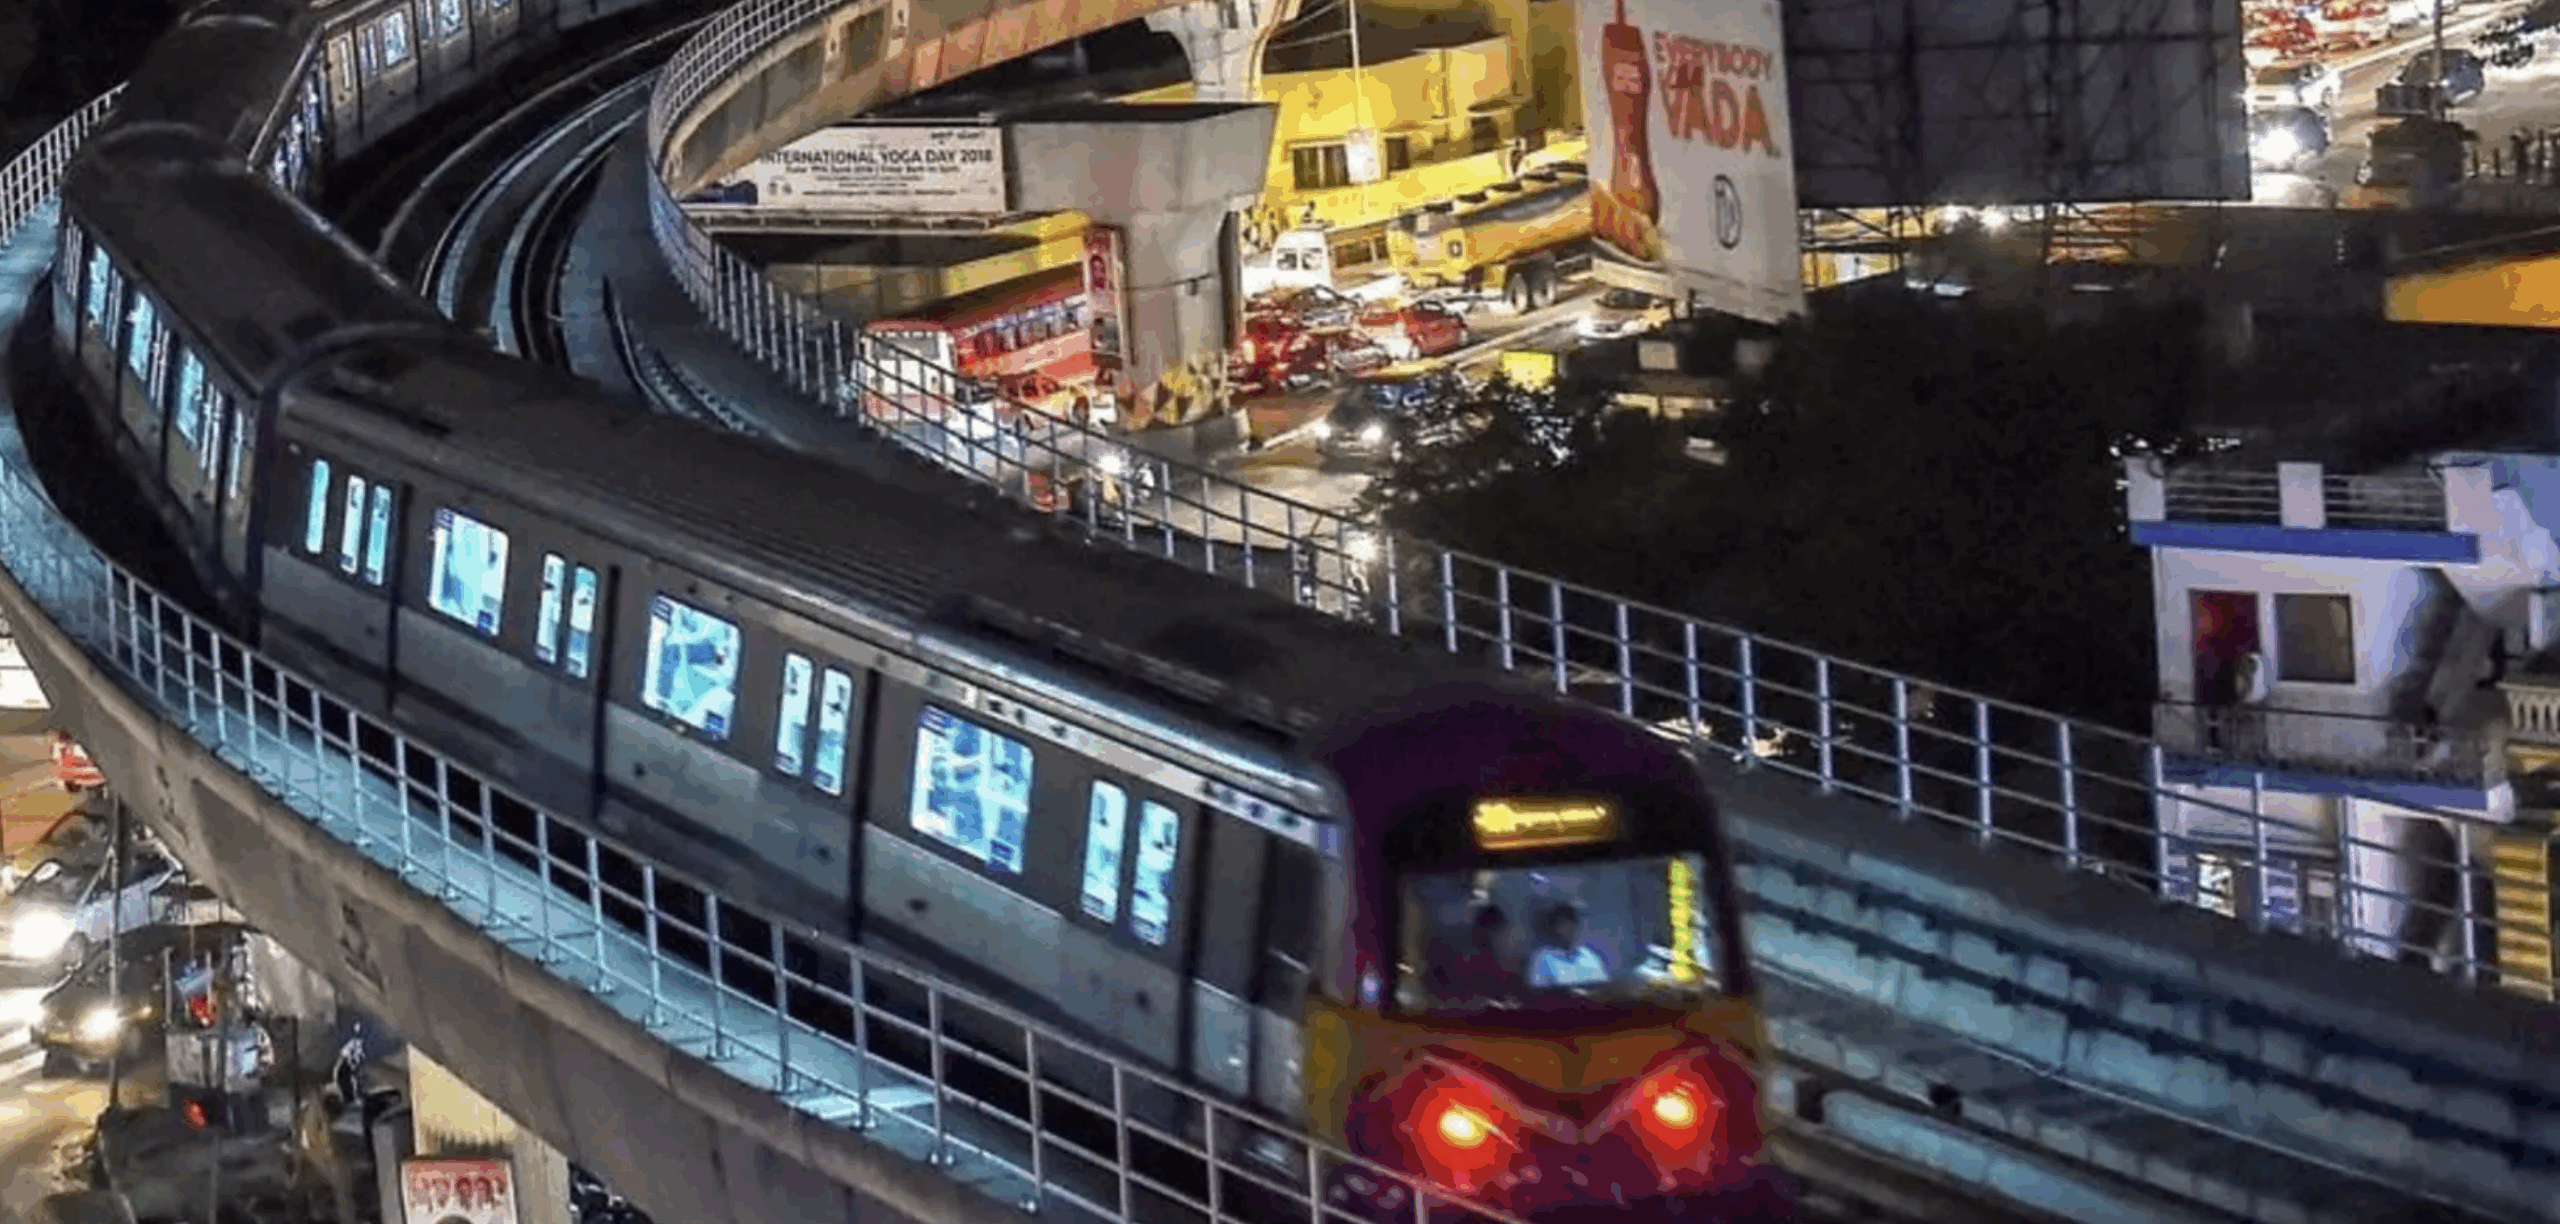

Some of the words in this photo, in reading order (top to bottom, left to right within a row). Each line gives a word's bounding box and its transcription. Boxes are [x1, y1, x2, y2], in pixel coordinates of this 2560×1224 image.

[879, 149, 922, 164] YOGA
[925, 149, 957, 163] DAY
[960, 149, 993, 163] 2018
